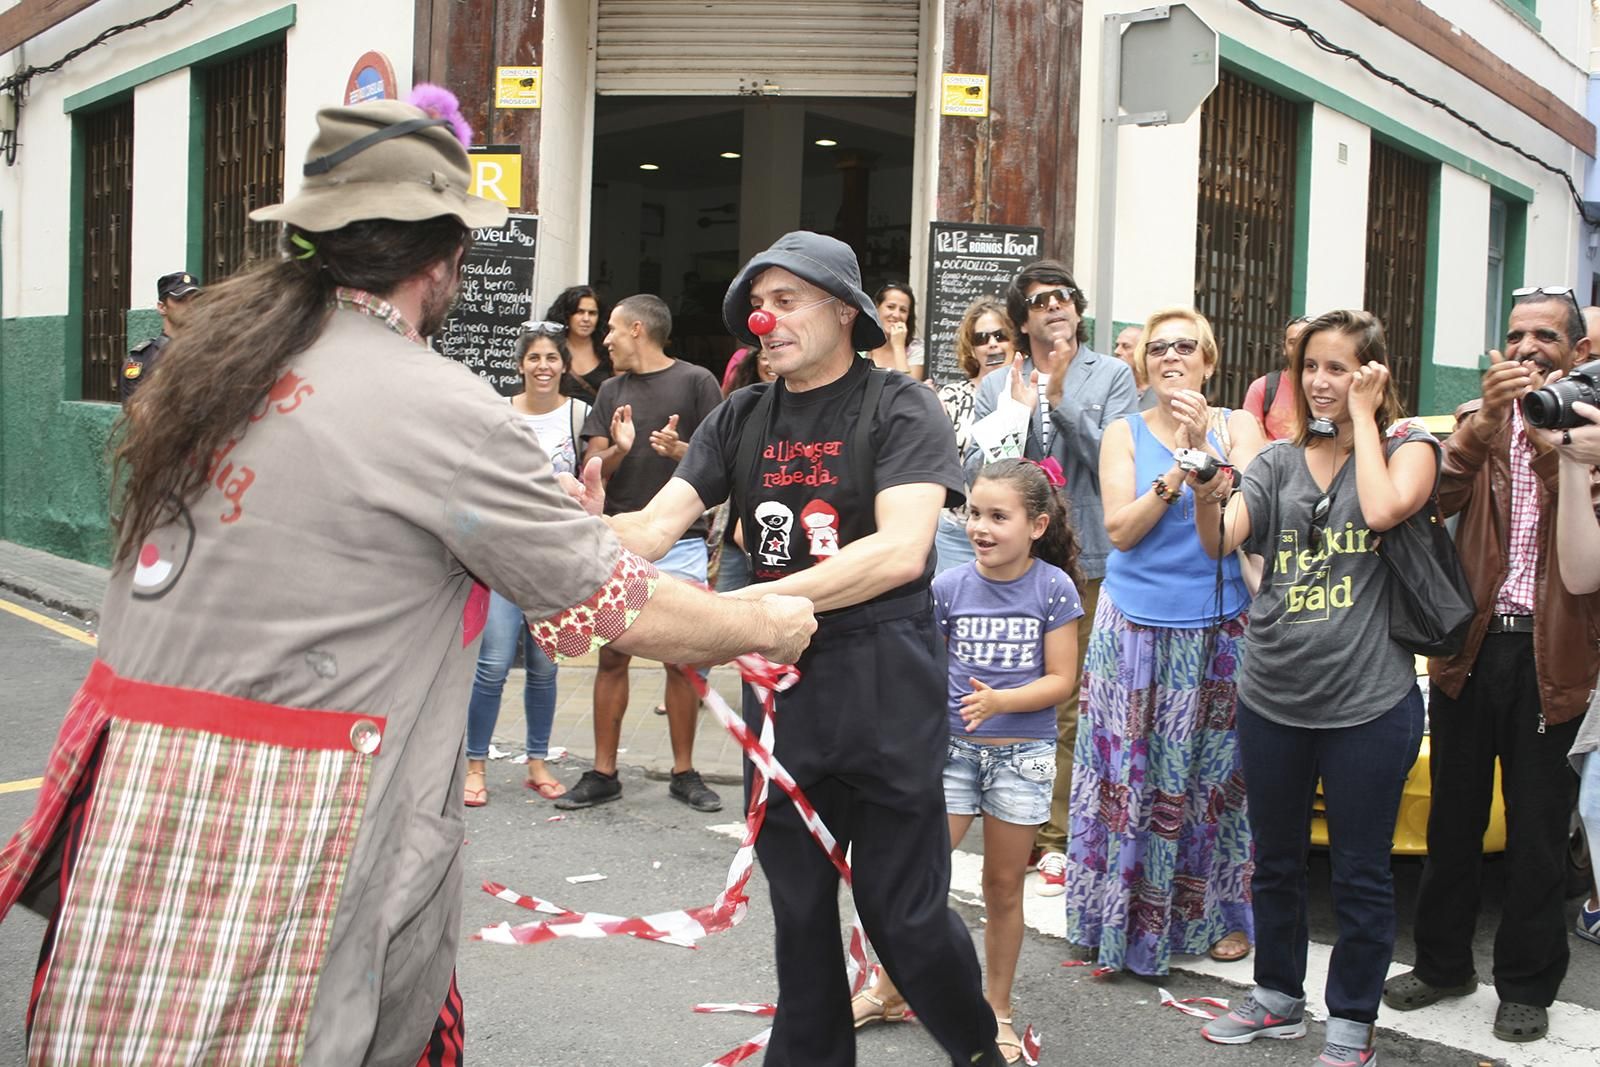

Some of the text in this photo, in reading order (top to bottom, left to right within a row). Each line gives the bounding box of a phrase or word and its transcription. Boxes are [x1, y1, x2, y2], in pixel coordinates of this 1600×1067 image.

[969, 241, 1003, 254] BORNOS
[460, 258, 512, 275] nsalada
[956, 617, 1040, 640] SUPER
[955, 641, 1038, 669] CUTE
